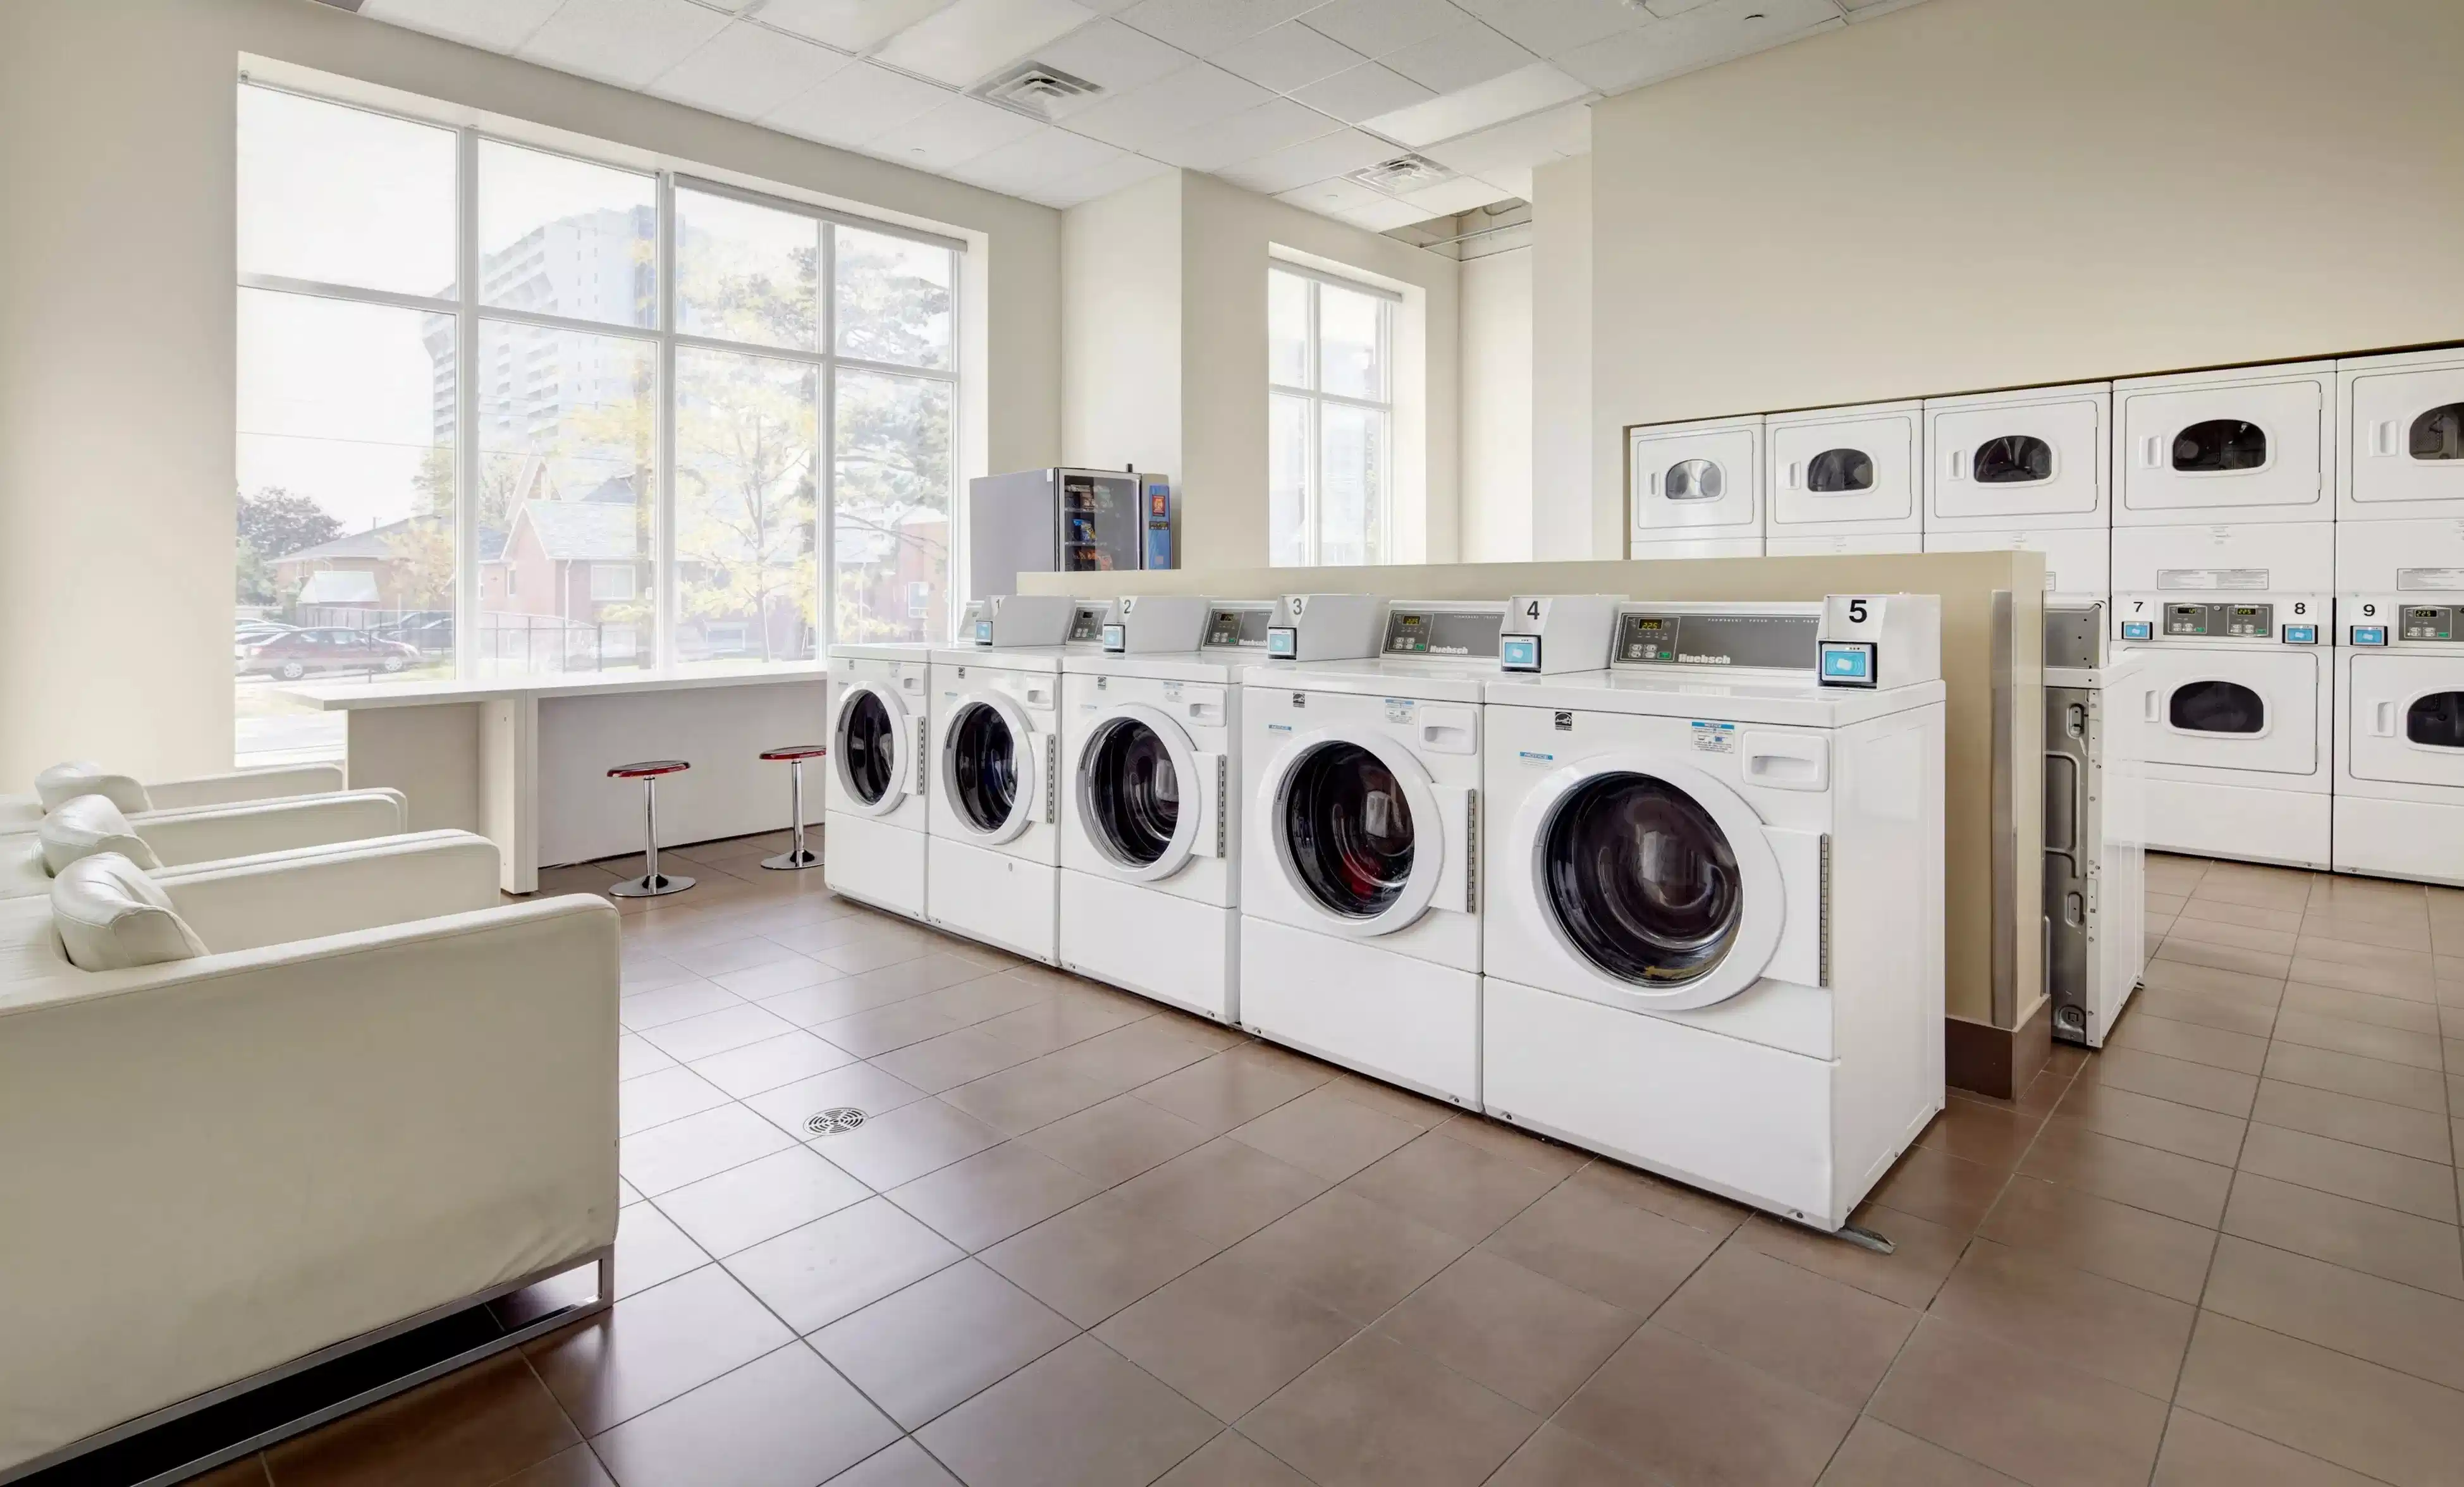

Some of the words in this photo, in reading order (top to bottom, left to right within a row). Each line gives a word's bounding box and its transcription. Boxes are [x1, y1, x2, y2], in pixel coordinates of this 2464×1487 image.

[996, 599, 1000, 609] 1
[1124, 599, 1131, 614] 2
[1292, 597, 1302, 615] 3
[2133, 601, 2143, 613] 7
[2294, 602, 2306, 615] 8
[2363, 604, 2375, 616] 9
[1526, 601, 1540, 620] 4
[1849, 599, 1867, 623] 5
[1641, 621, 1658, 630] 225
[1430, 645, 1468, 654] Huebsch
[1678, 653, 1731, 664] Huebsch
